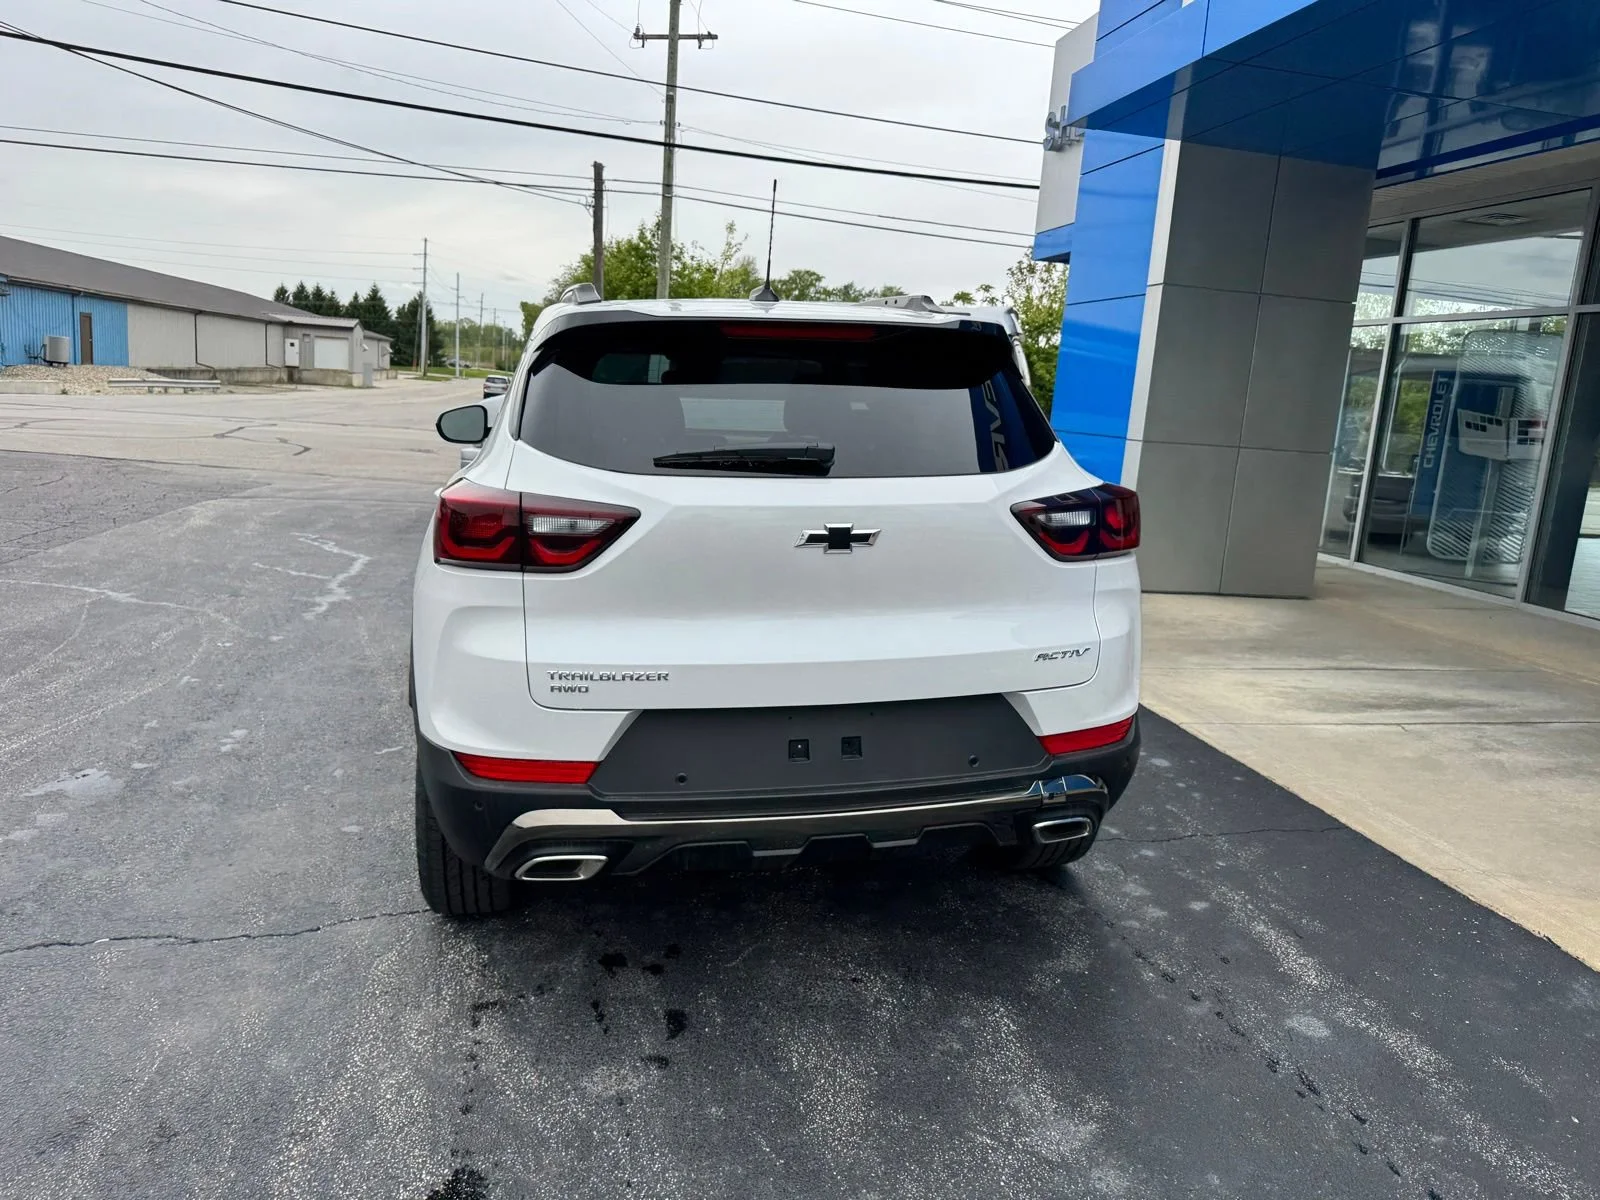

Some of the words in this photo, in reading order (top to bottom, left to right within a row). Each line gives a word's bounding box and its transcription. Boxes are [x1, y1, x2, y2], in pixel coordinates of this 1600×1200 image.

[1423, 376, 1448, 468] CHEVROLET
[1034, 647, 1091, 662] ACTIV
[547, 670, 669, 682] TRAILBLAZER
[550, 684, 589, 694] AWD
